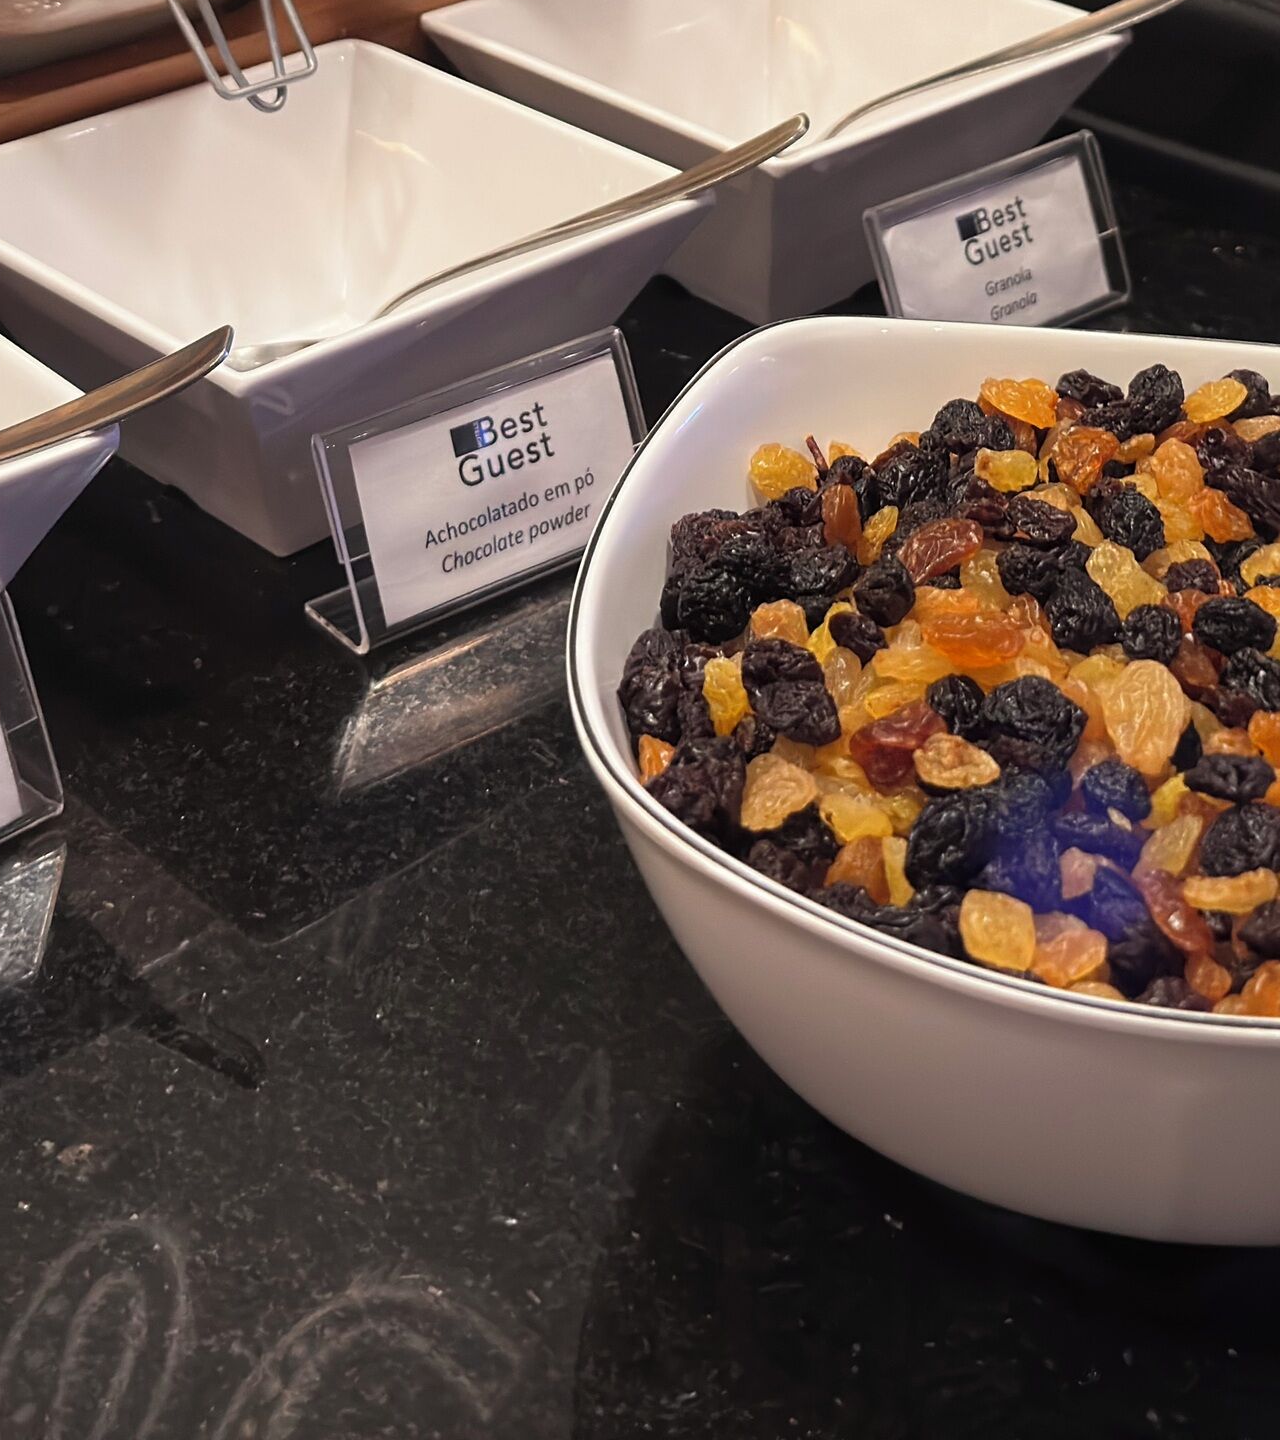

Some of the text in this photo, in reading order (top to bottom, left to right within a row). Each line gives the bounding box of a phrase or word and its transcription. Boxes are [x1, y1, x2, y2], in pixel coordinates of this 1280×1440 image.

[975, 195, 1027, 234] Best
[964, 221, 1034, 266] Guest
[984, 267, 1033, 297] Granola
[477, 401, 548, 449] Best
[458, 432, 555, 487] Guest
[424, 467, 595, 549] Achocolatado em pó
[441, 502, 592, 573] Chocolate powder
